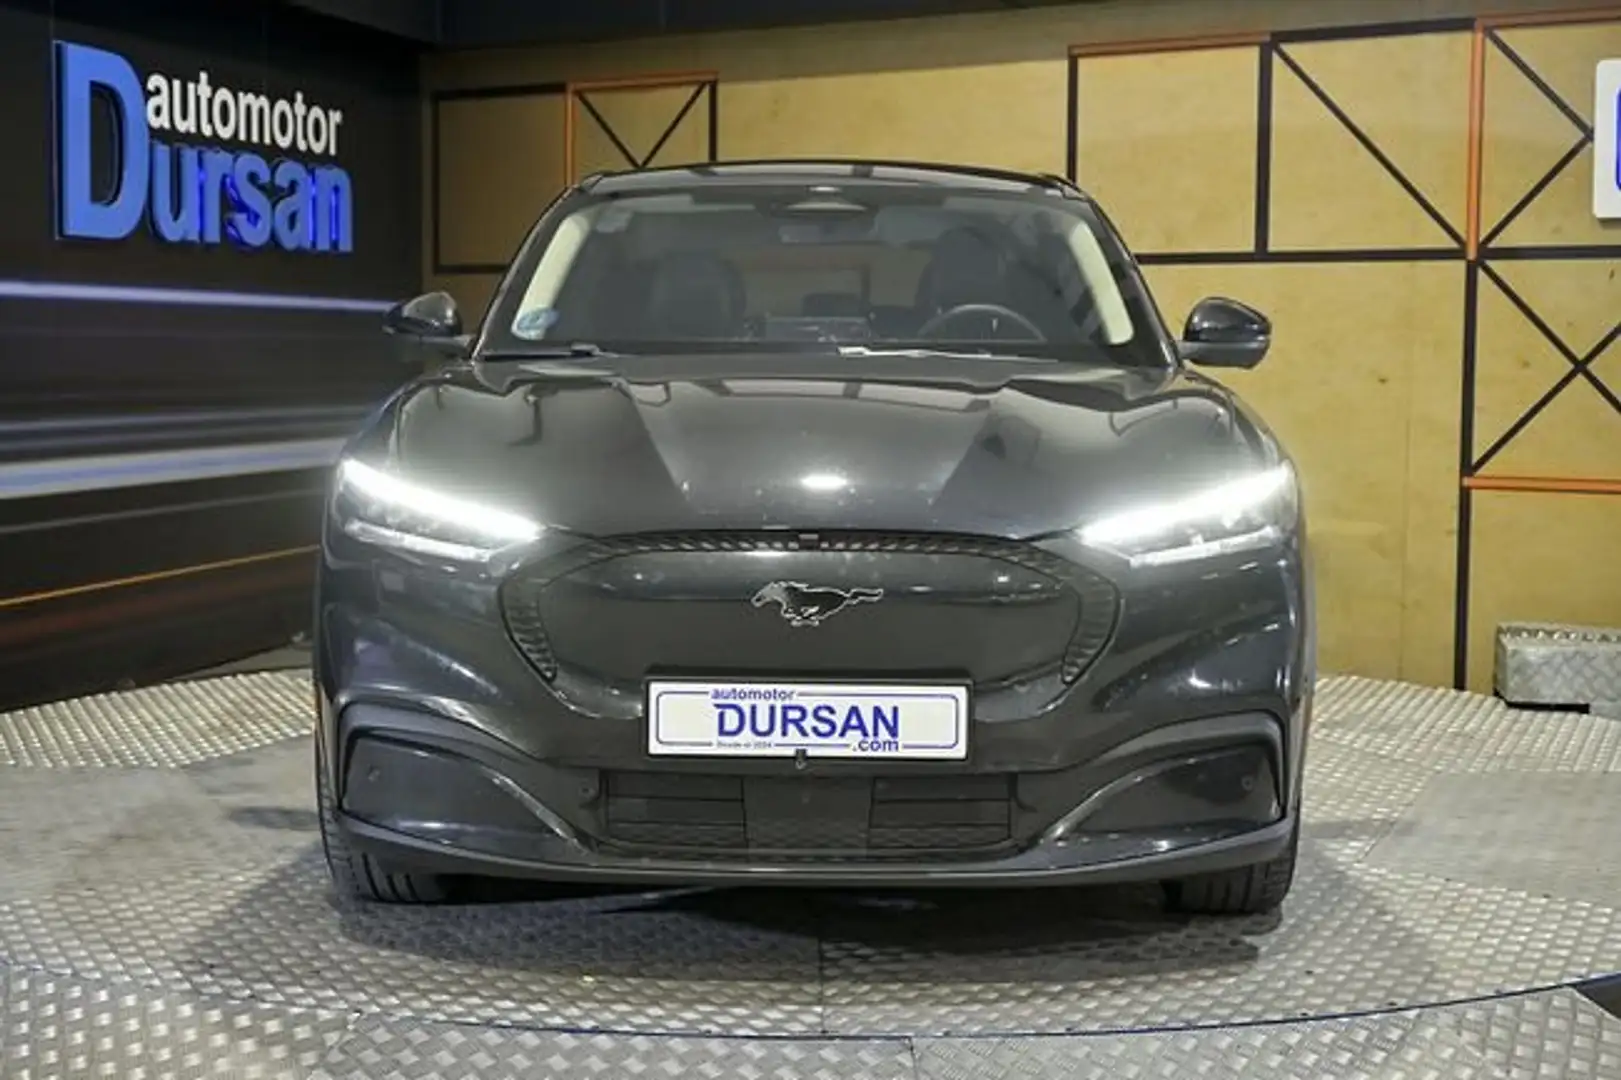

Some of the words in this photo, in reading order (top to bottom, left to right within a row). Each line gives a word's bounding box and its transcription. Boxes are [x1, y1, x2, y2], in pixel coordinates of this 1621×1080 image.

[146, 71, 343, 155] automotor
[57, 40, 353, 252] Dursan
[711, 688, 795, 700] automotor
[713, 703, 899, 738] DURSAN
[852, 737, 899, 751] .com
